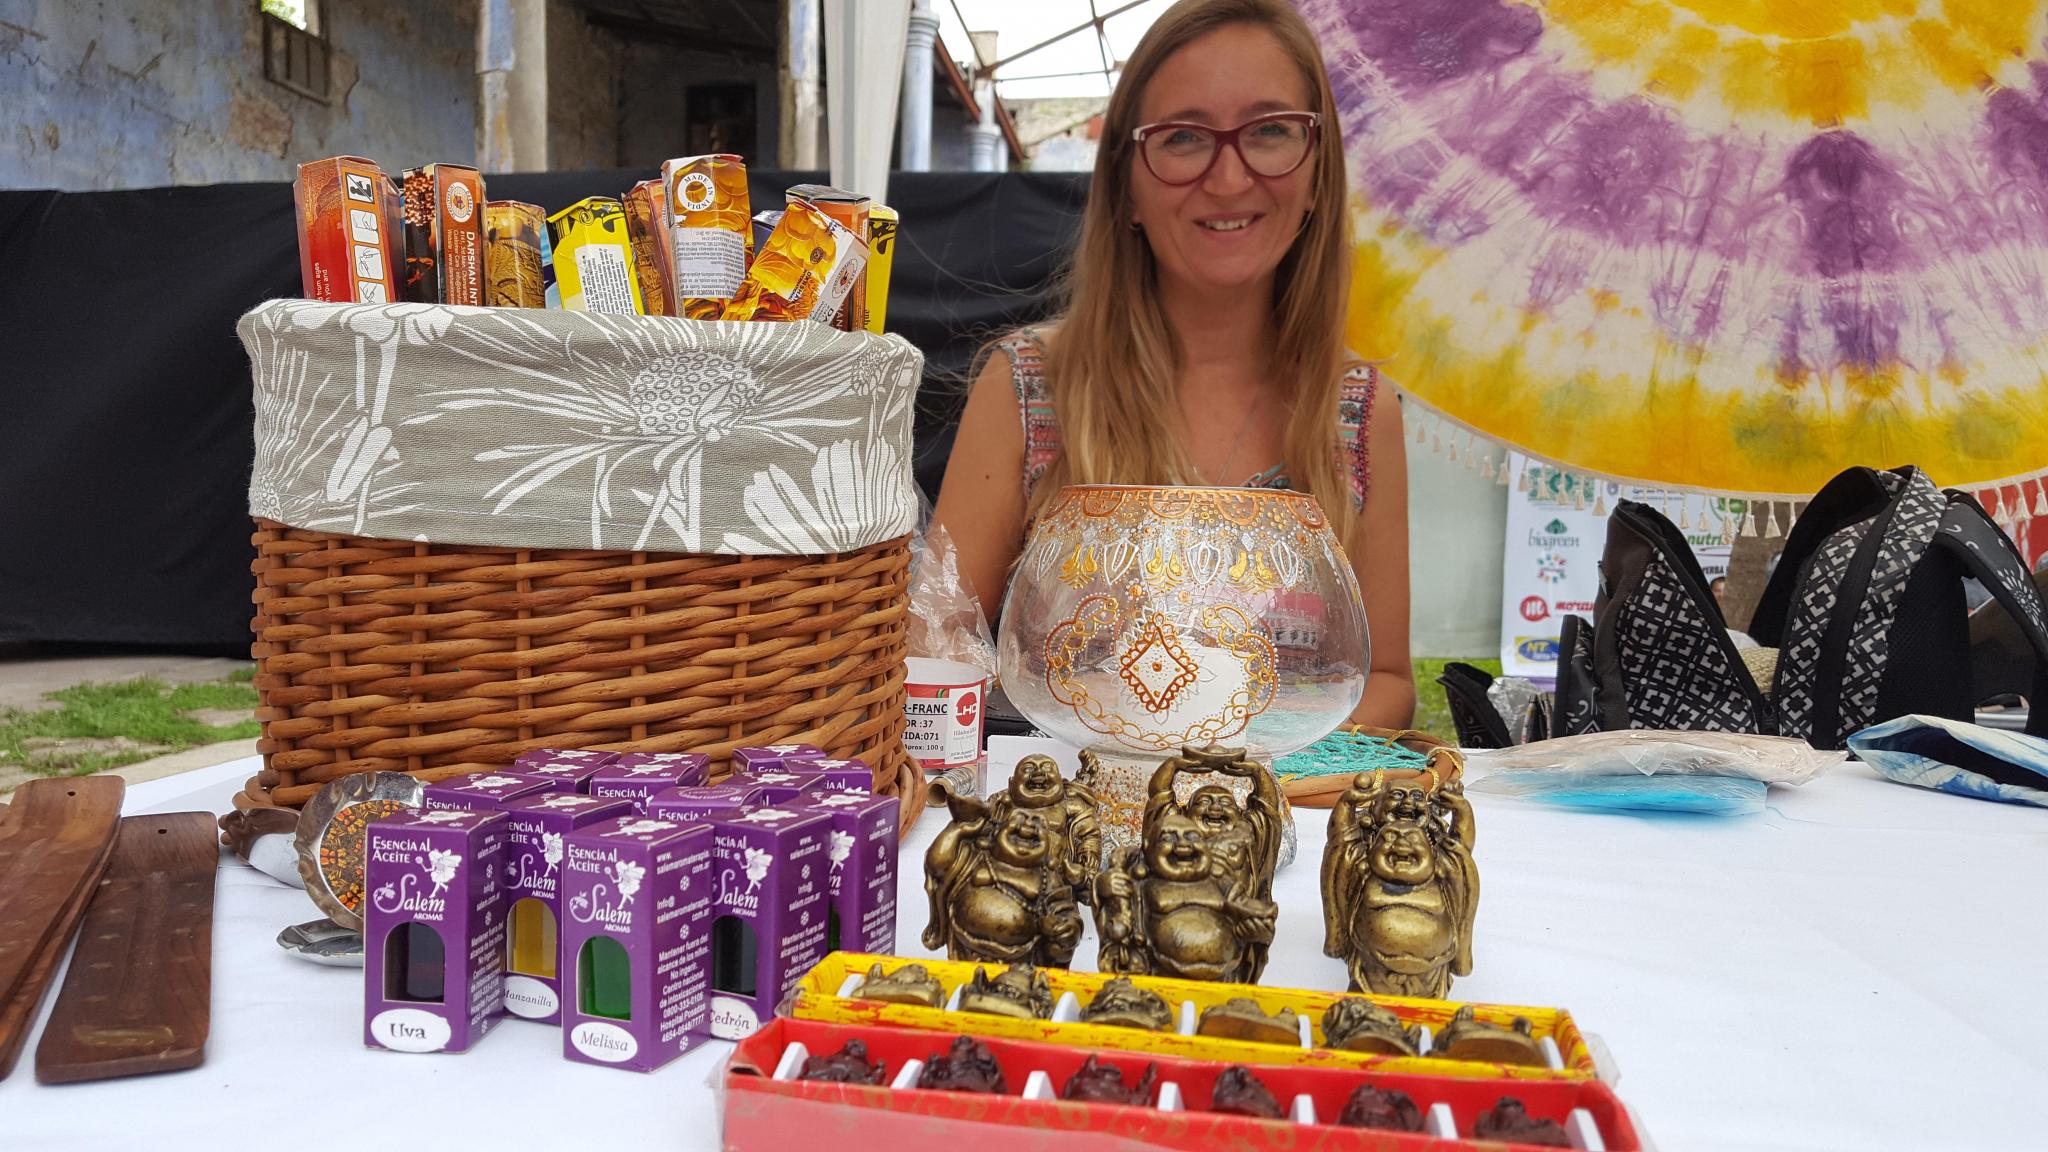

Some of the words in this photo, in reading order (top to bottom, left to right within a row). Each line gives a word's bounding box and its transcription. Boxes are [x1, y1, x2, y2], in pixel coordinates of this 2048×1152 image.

[684, 174, 709, 184] MADE
[707, 186, 714, 196] IN
[687, 198, 711, 210] INDIA
[466, 231, 477, 285] DARSHAN
[927, 743, 939, 751] 100
[506, 853, 556, 891] Salem
[691, 860, 710, 875] com.ar
[373, 873, 445, 914] Salem
[531, 890, 555, 899] AROMAS
[712, 869, 759, 909] Salem
[569, 883, 632, 924] Salem
[413, 912, 444, 921] AROMAS
[691, 907, 710, 922] com.ar
[731, 907, 757, 918] AROMAS
[603, 923, 631, 934] AROMAS
[658, 943, 686, 962] Mantener
[685, 938, 700, 952] fuera
[700, 933, 709, 944] del
[657, 958, 679, 975] alcance
[679, 955, 686, 965] de
[686, 951, 694, 961] los
[662, 979, 682, 996] Centro
[682, 968, 704, 986] nacional
[670, 969, 679, 981] No
[503, 988, 552, 1008] Manzanilla
[659, 998, 667, 1009] de
[660, 1013, 684, 1032] Hospital
[683, 1003, 706, 1021] Posadas
[711, 1010, 750, 1030] Cedrón
[390, 1022, 427, 1039] Uva
[580, 1031, 628, 1051] Melissa
